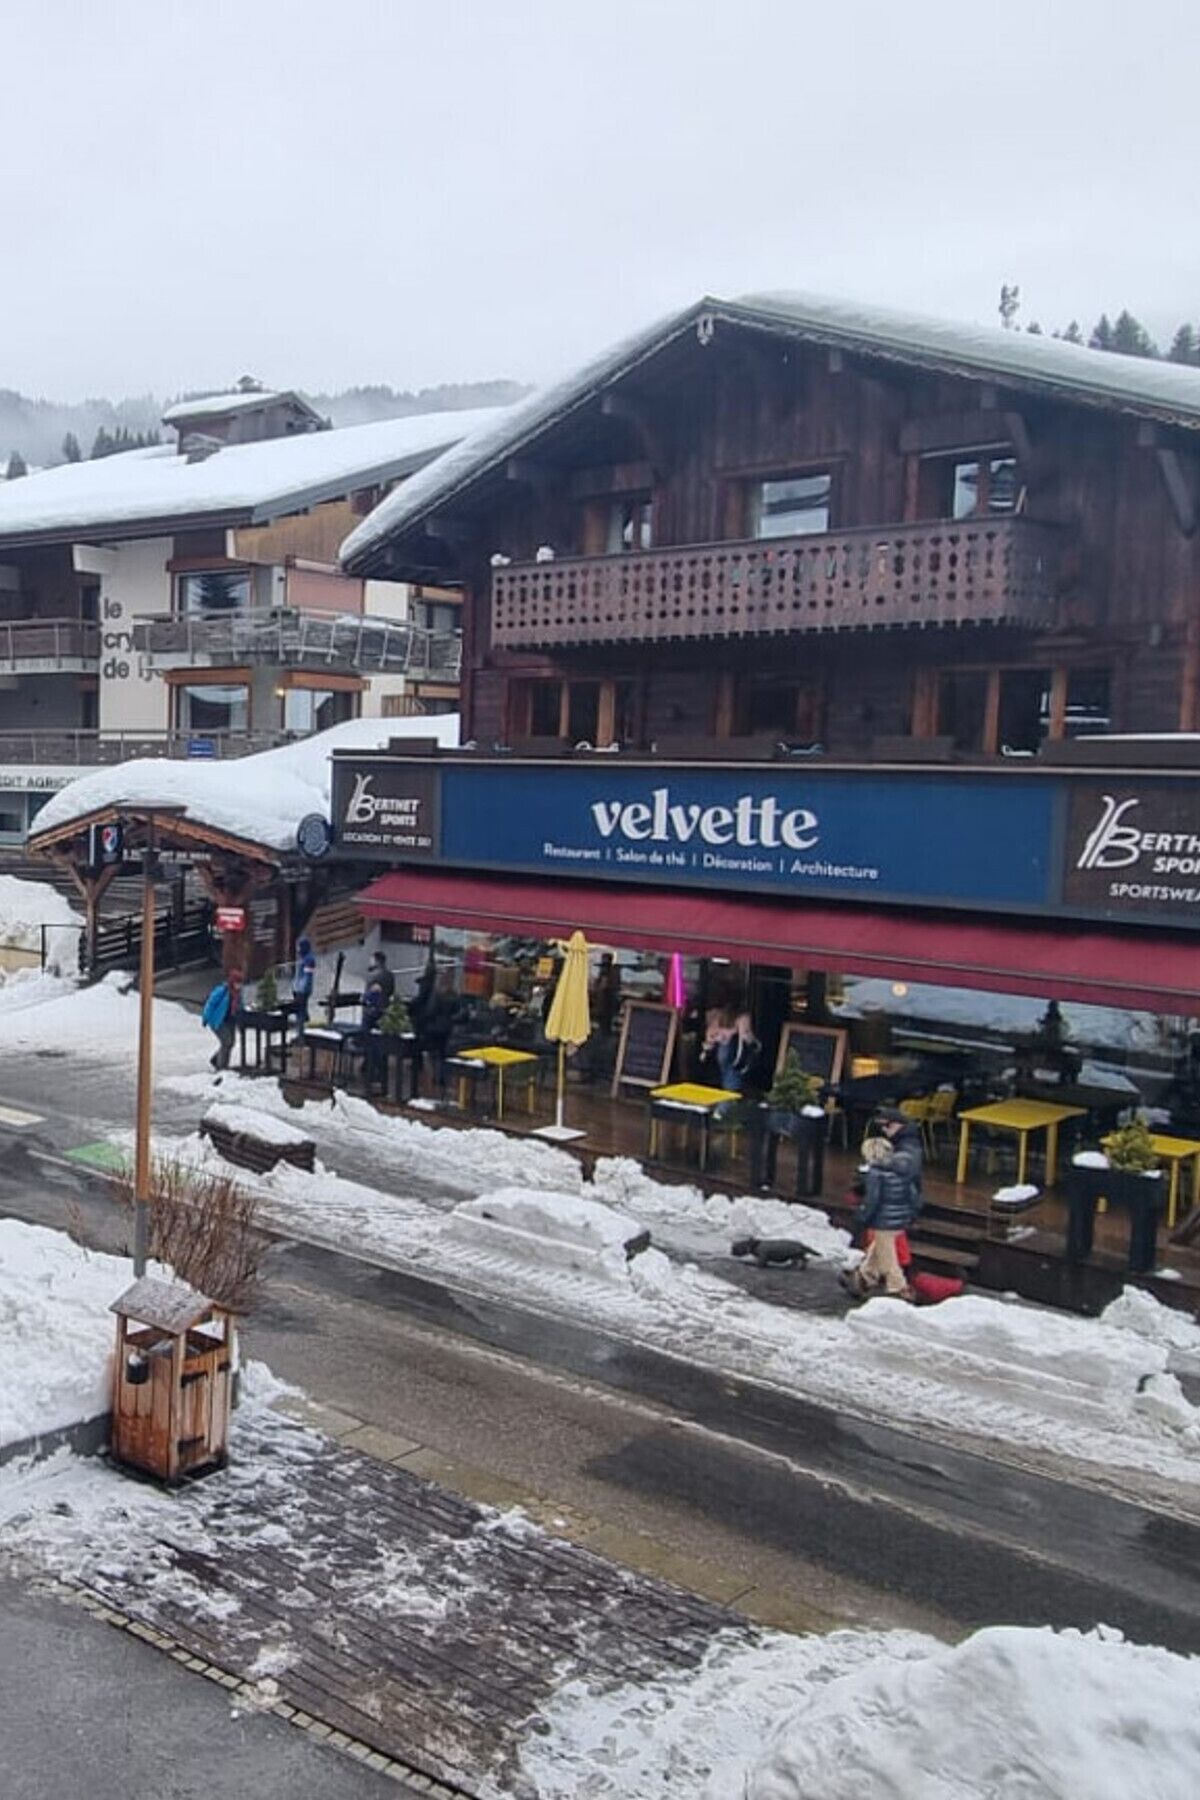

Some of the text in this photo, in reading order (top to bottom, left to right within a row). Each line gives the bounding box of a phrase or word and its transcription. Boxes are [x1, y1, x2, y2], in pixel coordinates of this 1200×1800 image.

[103, 597, 122, 619] le
[103, 657, 130, 679] de
[591, 788, 819, 850] velvette
[544, 843, 879, 879] Restaurant Salon de thé Décoration Architecture
